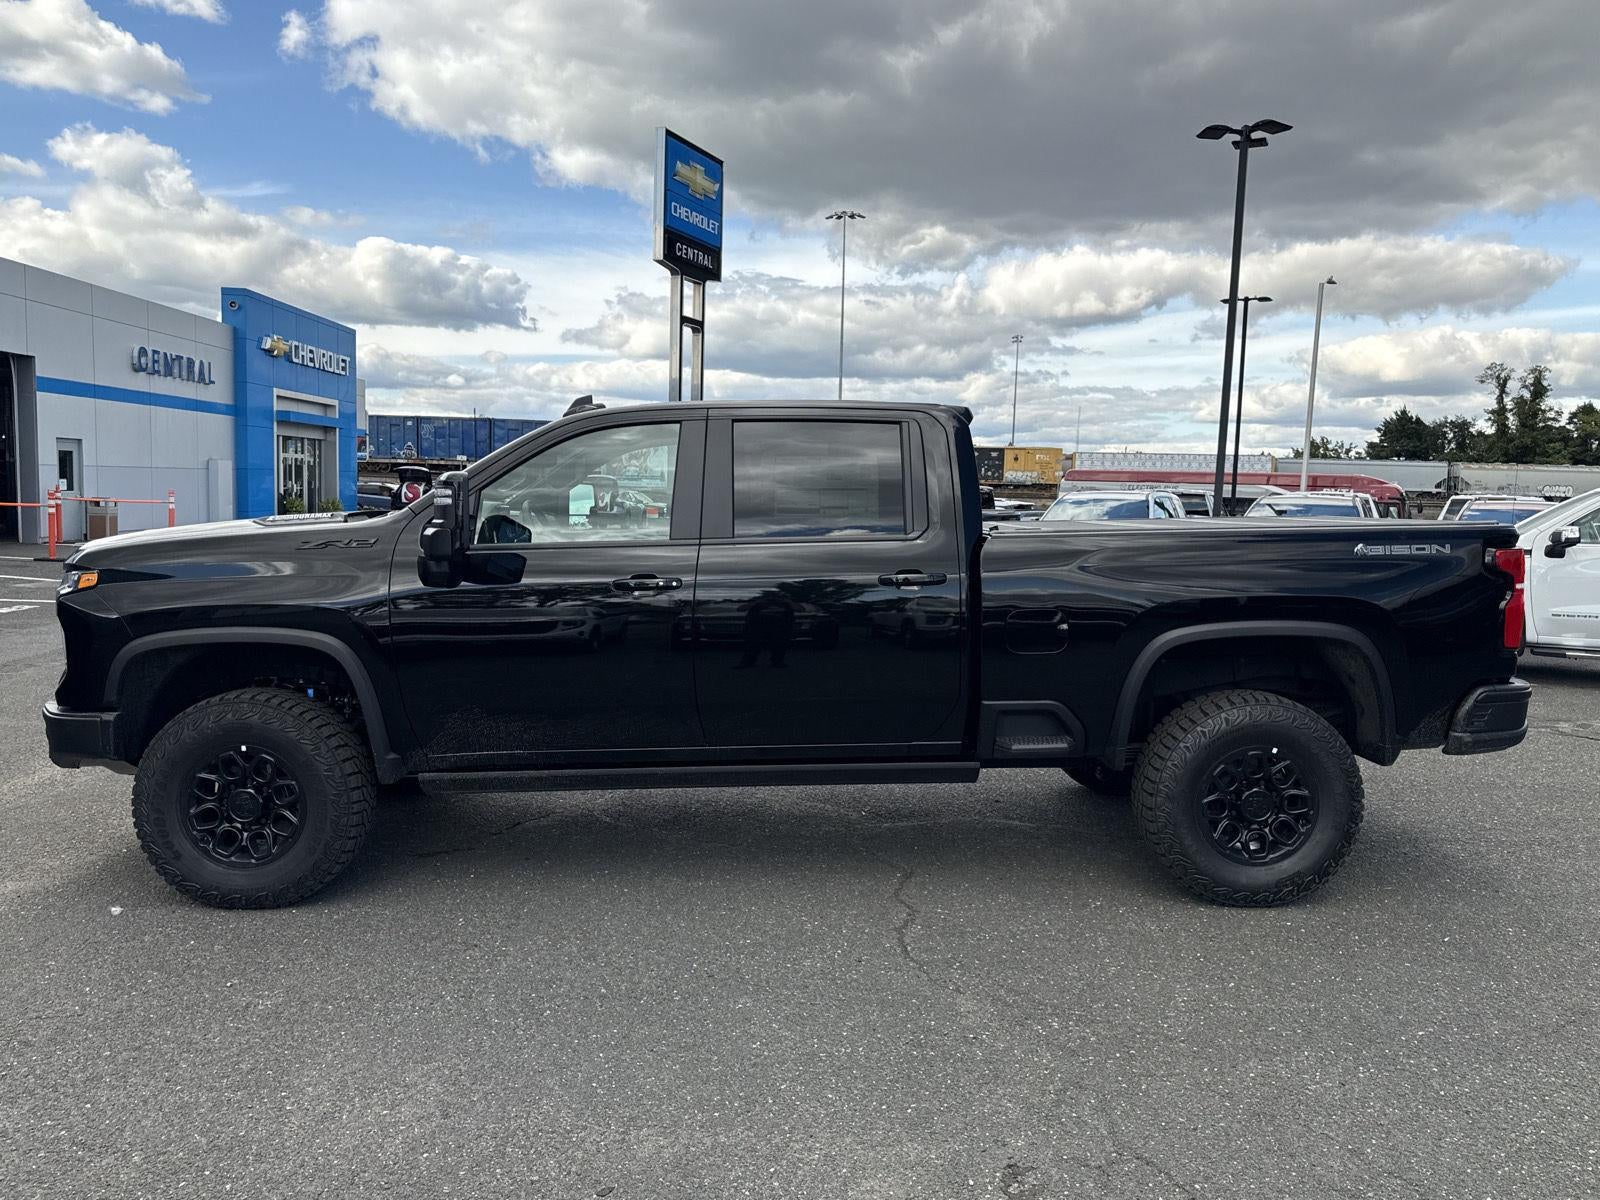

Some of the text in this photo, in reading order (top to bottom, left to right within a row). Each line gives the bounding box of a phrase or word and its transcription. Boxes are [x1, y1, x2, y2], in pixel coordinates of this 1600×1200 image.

[671, 201, 719, 235] CHEVROLET
[676, 243, 713, 269] CENTRAL
[132, 346, 216, 385] CENTRAL
[291, 340, 350, 376] CHEVROLET
[1366, 543, 1451, 555] BISON
